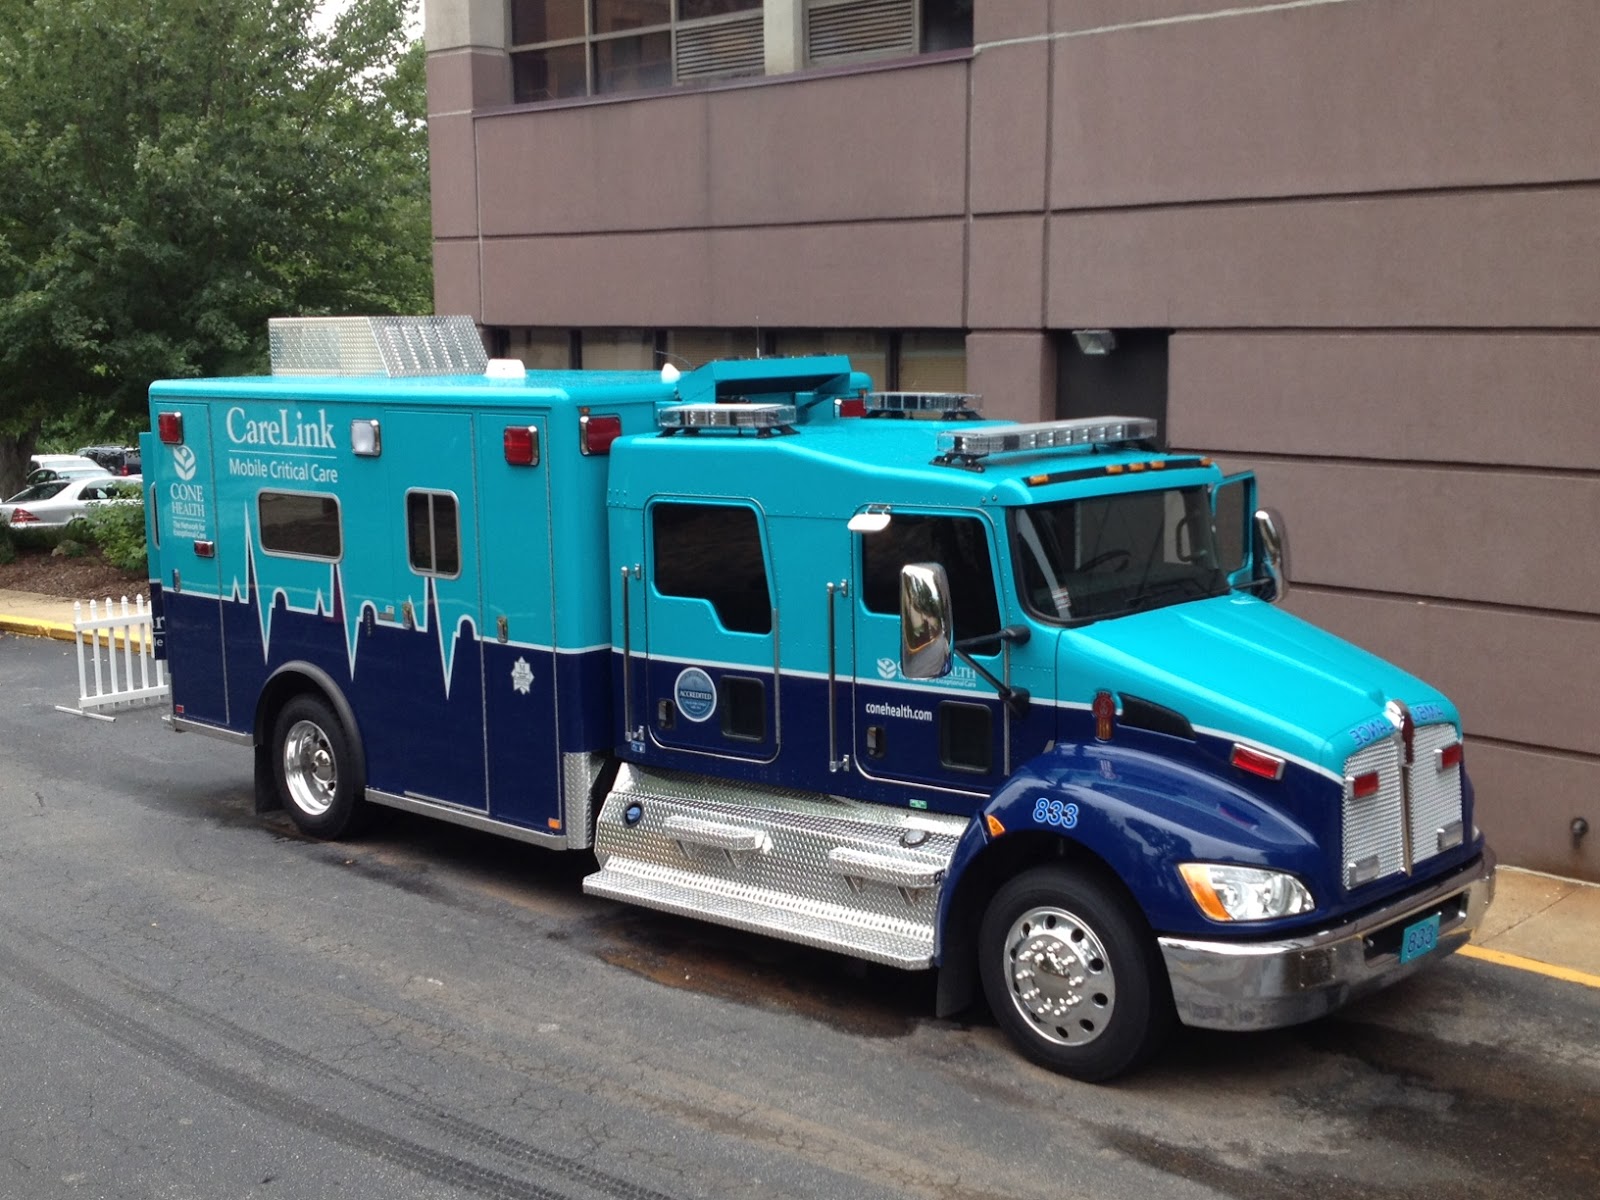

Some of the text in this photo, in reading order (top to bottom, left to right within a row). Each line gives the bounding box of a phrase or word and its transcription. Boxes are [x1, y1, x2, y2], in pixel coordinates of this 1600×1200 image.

[226, 406, 337, 449] CareLink
[229, 457, 338, 483] Mobile Critical Care
[170, 482, 204, 502] CONE
[171, 501, 205, 517] HEALTH
[680, 690, 712, 700] ACCREDITED
[865, 702, 933, 721] conehealth.com
[1032, 797, 1079, 829] 833
[1408, 924, 1434, 954] 833
